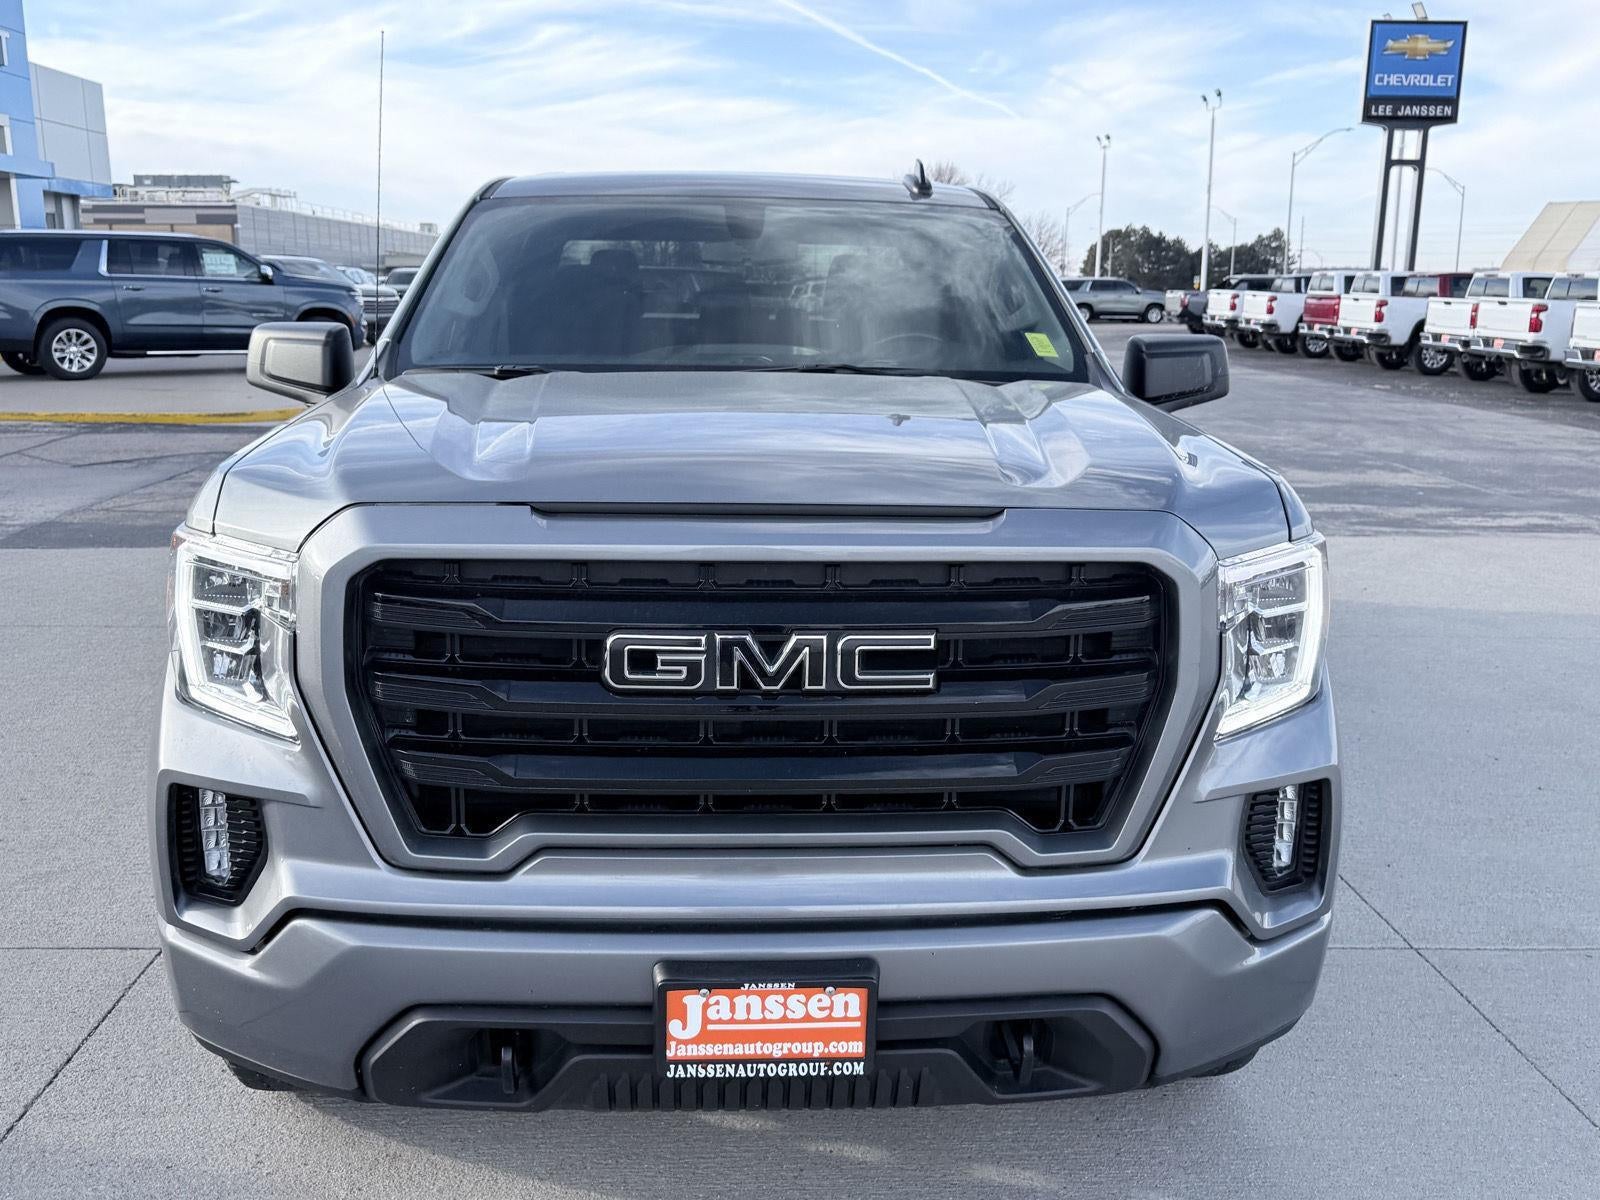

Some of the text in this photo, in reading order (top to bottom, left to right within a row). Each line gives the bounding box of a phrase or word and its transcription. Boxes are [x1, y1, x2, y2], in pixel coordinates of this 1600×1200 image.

[1374, 73, 1454, 86] CHEVROLET
[1371, 104, 1452, 116] LEE JANSSEN
[604, 632, 937, 692] GMC
[741, 982, 796, 990] JANSSEN
[668, 992, 861, 1039] Janssen
[666, 1041, 863, 1057] Janssenautogroup.com
[666, 1062, 864, 1078] JANSSENAUTOGROUP.COM
